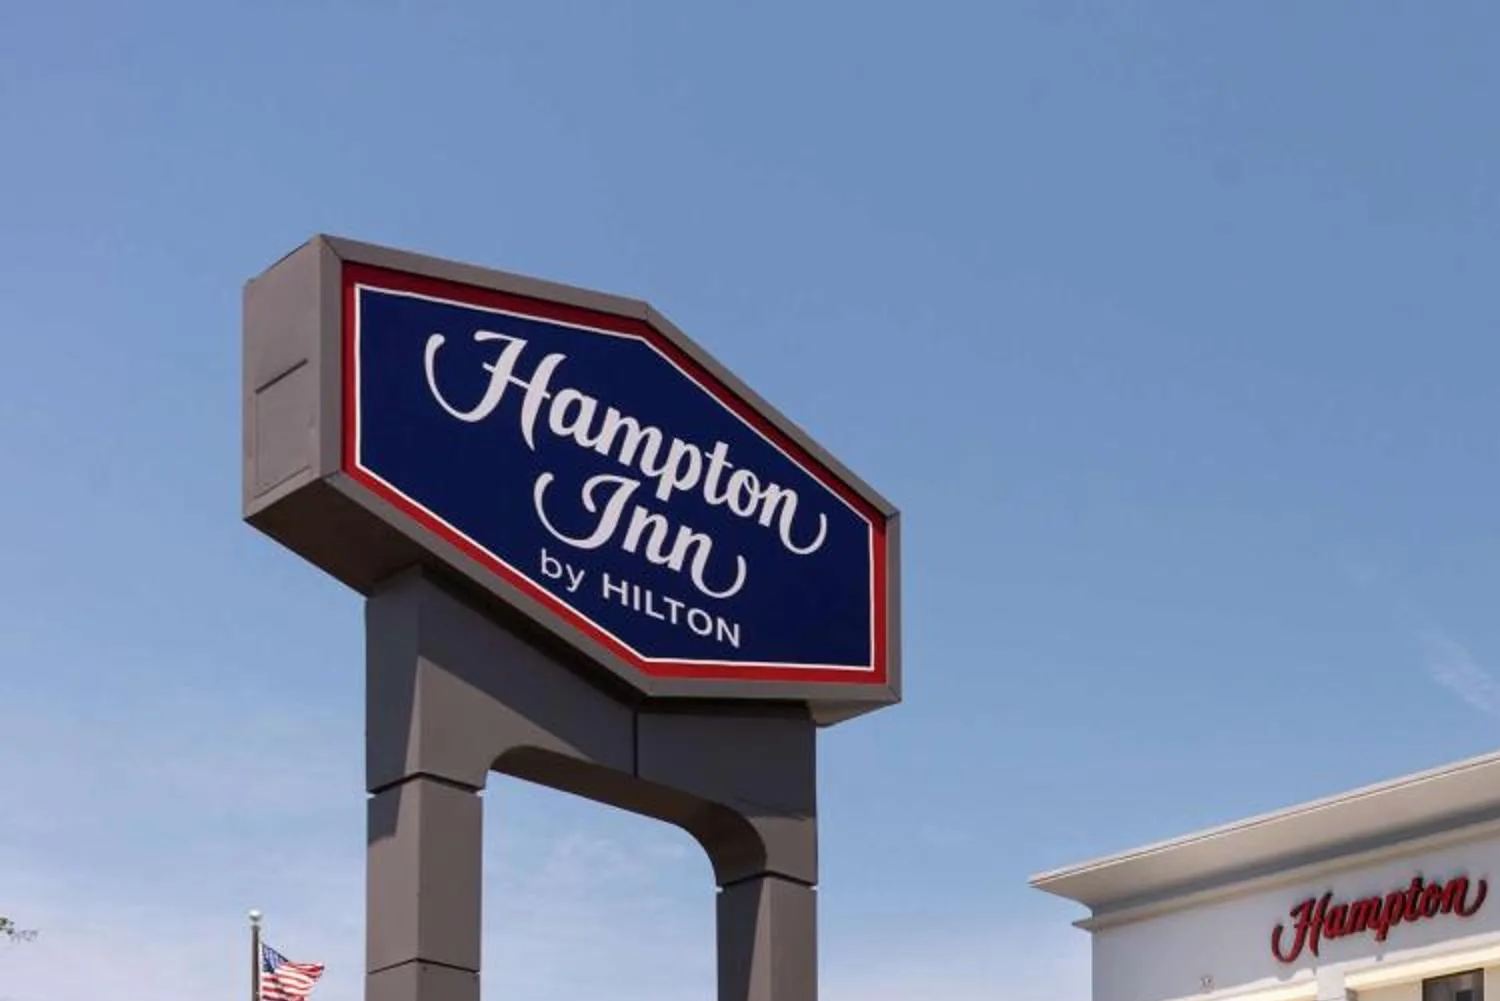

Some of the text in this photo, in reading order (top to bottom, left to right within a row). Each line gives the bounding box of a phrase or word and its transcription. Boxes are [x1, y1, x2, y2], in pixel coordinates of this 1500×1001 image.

[424, 330, 828, 554] Hampton
[534, 472, 747, 598] Inn
[540, 549, 741, 648] by HILTON
[1271, 873, 1487, 963] Hampton
